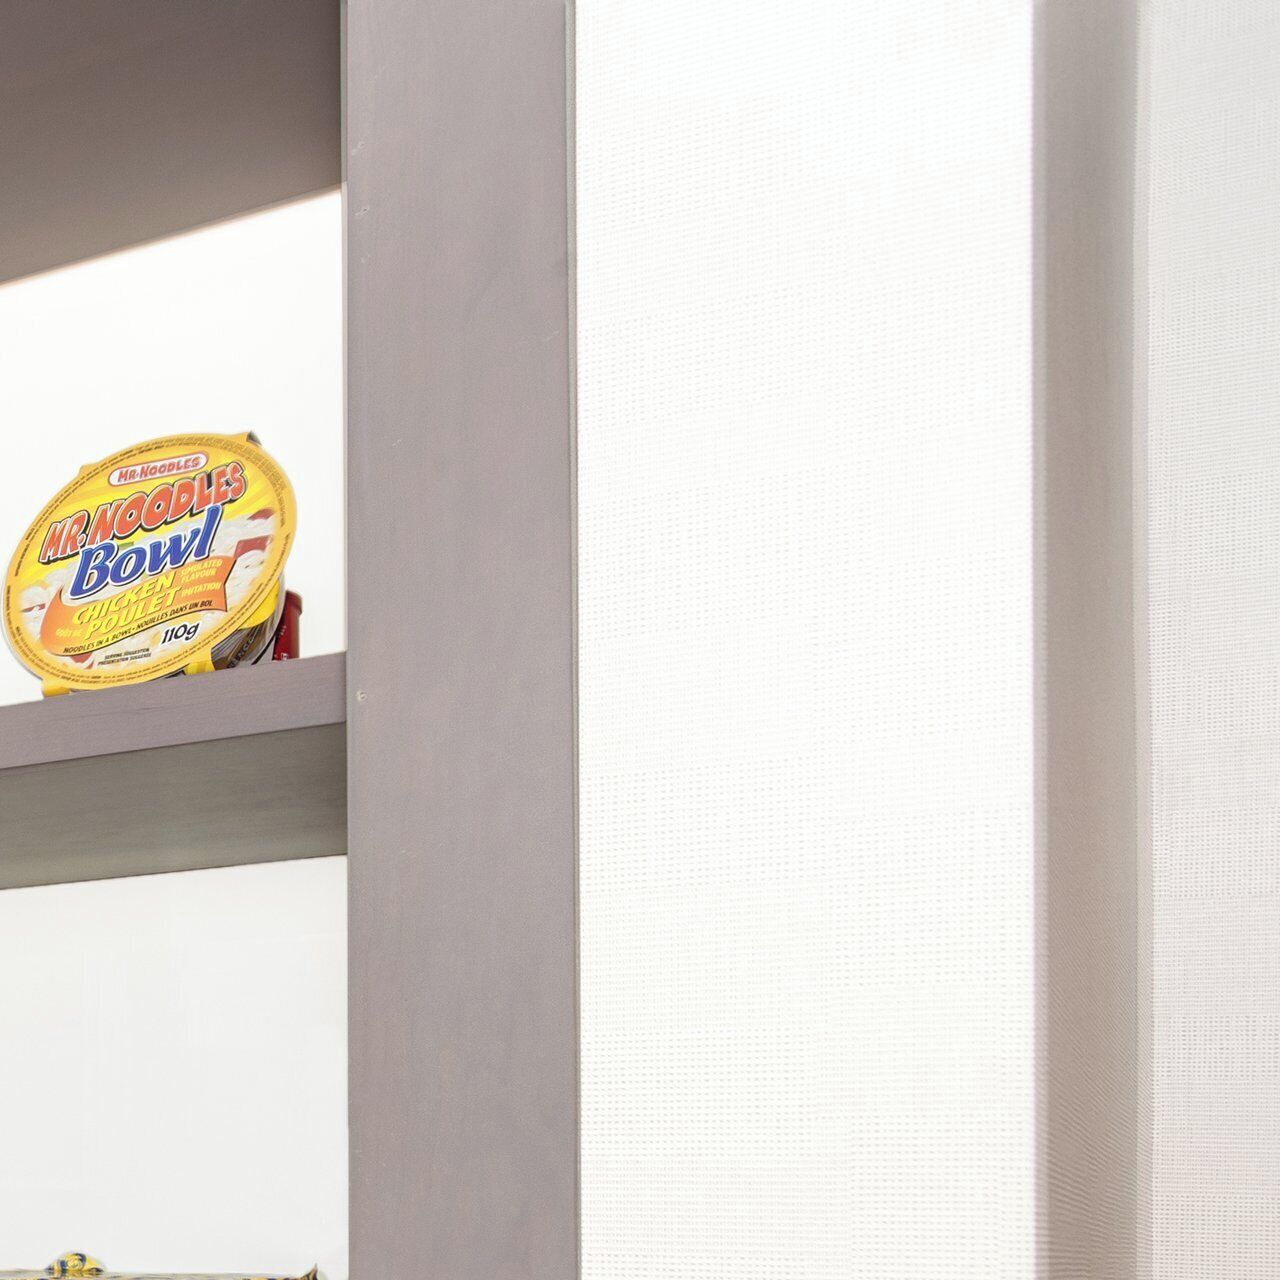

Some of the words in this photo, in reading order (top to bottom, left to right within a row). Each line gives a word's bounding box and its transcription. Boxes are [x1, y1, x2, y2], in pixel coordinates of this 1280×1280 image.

[88, 462, 247, 546] NOODLES
[70, 505, 223, 599] Bowl
[180, 569, 217, 583] FLAVOUR
[72, 571, 177, 626] CHICKEN
[84, 586, 183, 640] POULET
[63, 642, 96, 654] NOODLES
[111, 628, 132, 641] BOWL
[161, 622, 200, 646] 110g
